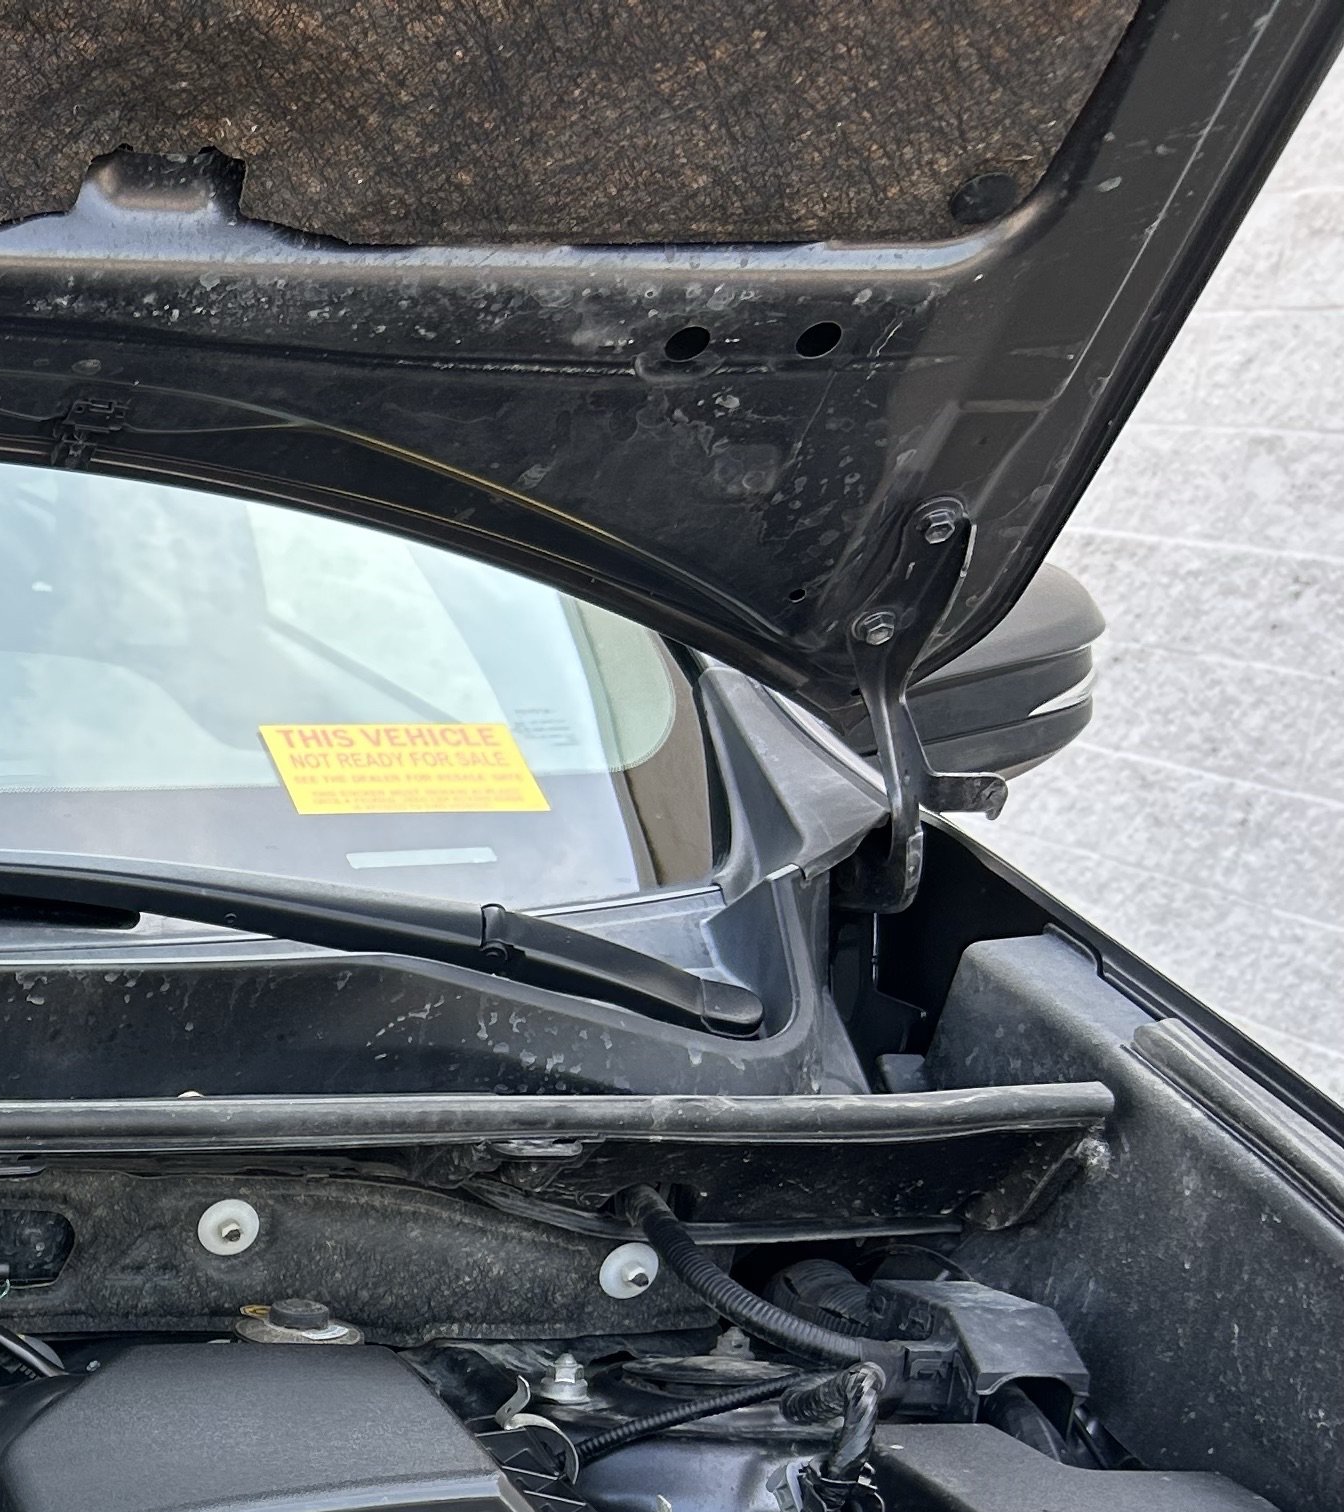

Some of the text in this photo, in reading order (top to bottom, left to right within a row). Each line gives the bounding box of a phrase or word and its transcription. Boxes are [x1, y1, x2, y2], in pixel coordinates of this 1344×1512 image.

[276, 729, 354, 748] THIS
[360, 727, 502, 747] VEHICLE
[290, 751, 511, 769] NOT READY FOR SALE
